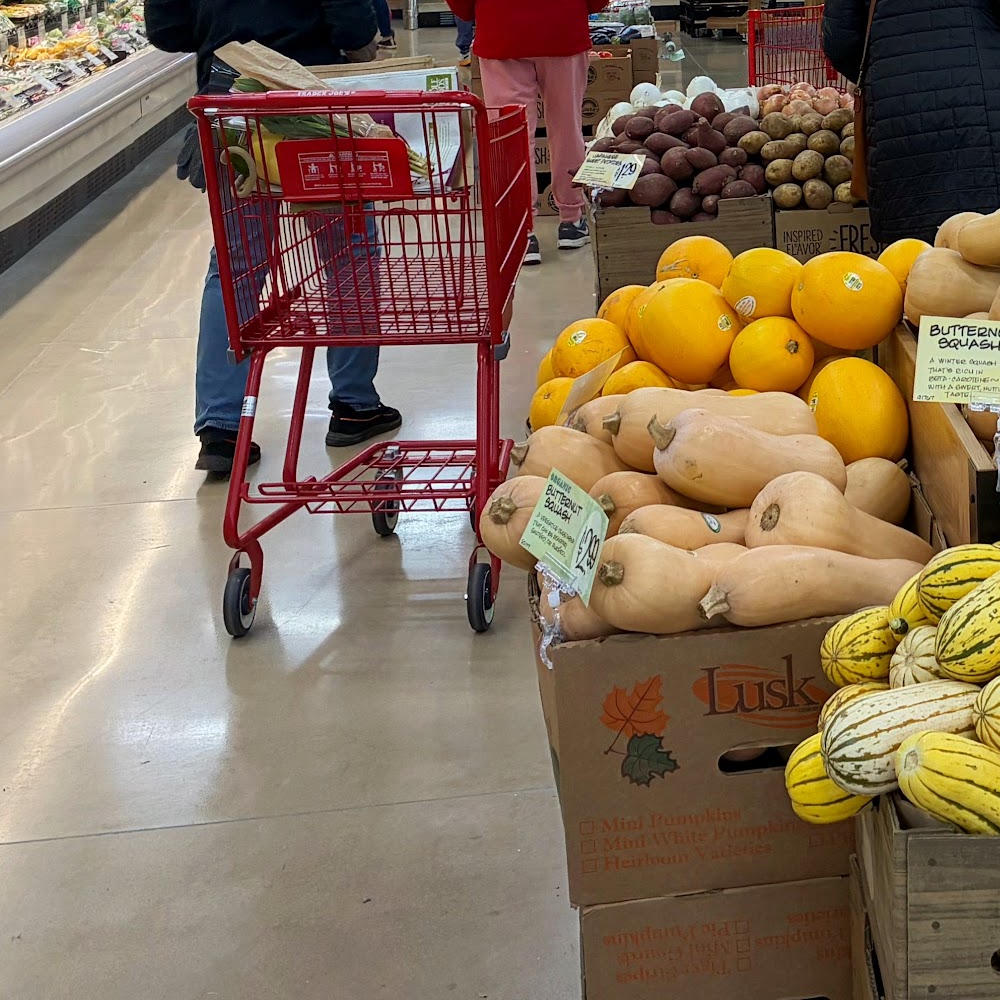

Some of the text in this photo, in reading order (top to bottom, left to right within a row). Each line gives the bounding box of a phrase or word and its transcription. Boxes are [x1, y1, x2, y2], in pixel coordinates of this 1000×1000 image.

[783, 229, 824, 244] INSPIRED
[550, 473, 572, 494] ORGANIC
[544, 498, 573, 525] SQUASH
[545, 484, 583, 515] BUTTERNUT
[700, 653, 820, 716] Lusk
[600, 807, 742, 833] Mini Pumpkins
[602, 834, 645, 852] Mini
[651, 830, 706, 849] White
[603, 843, 772, 872] Heirloom Varieties
[602, 920, 731, 947] Pie Pumpkins
